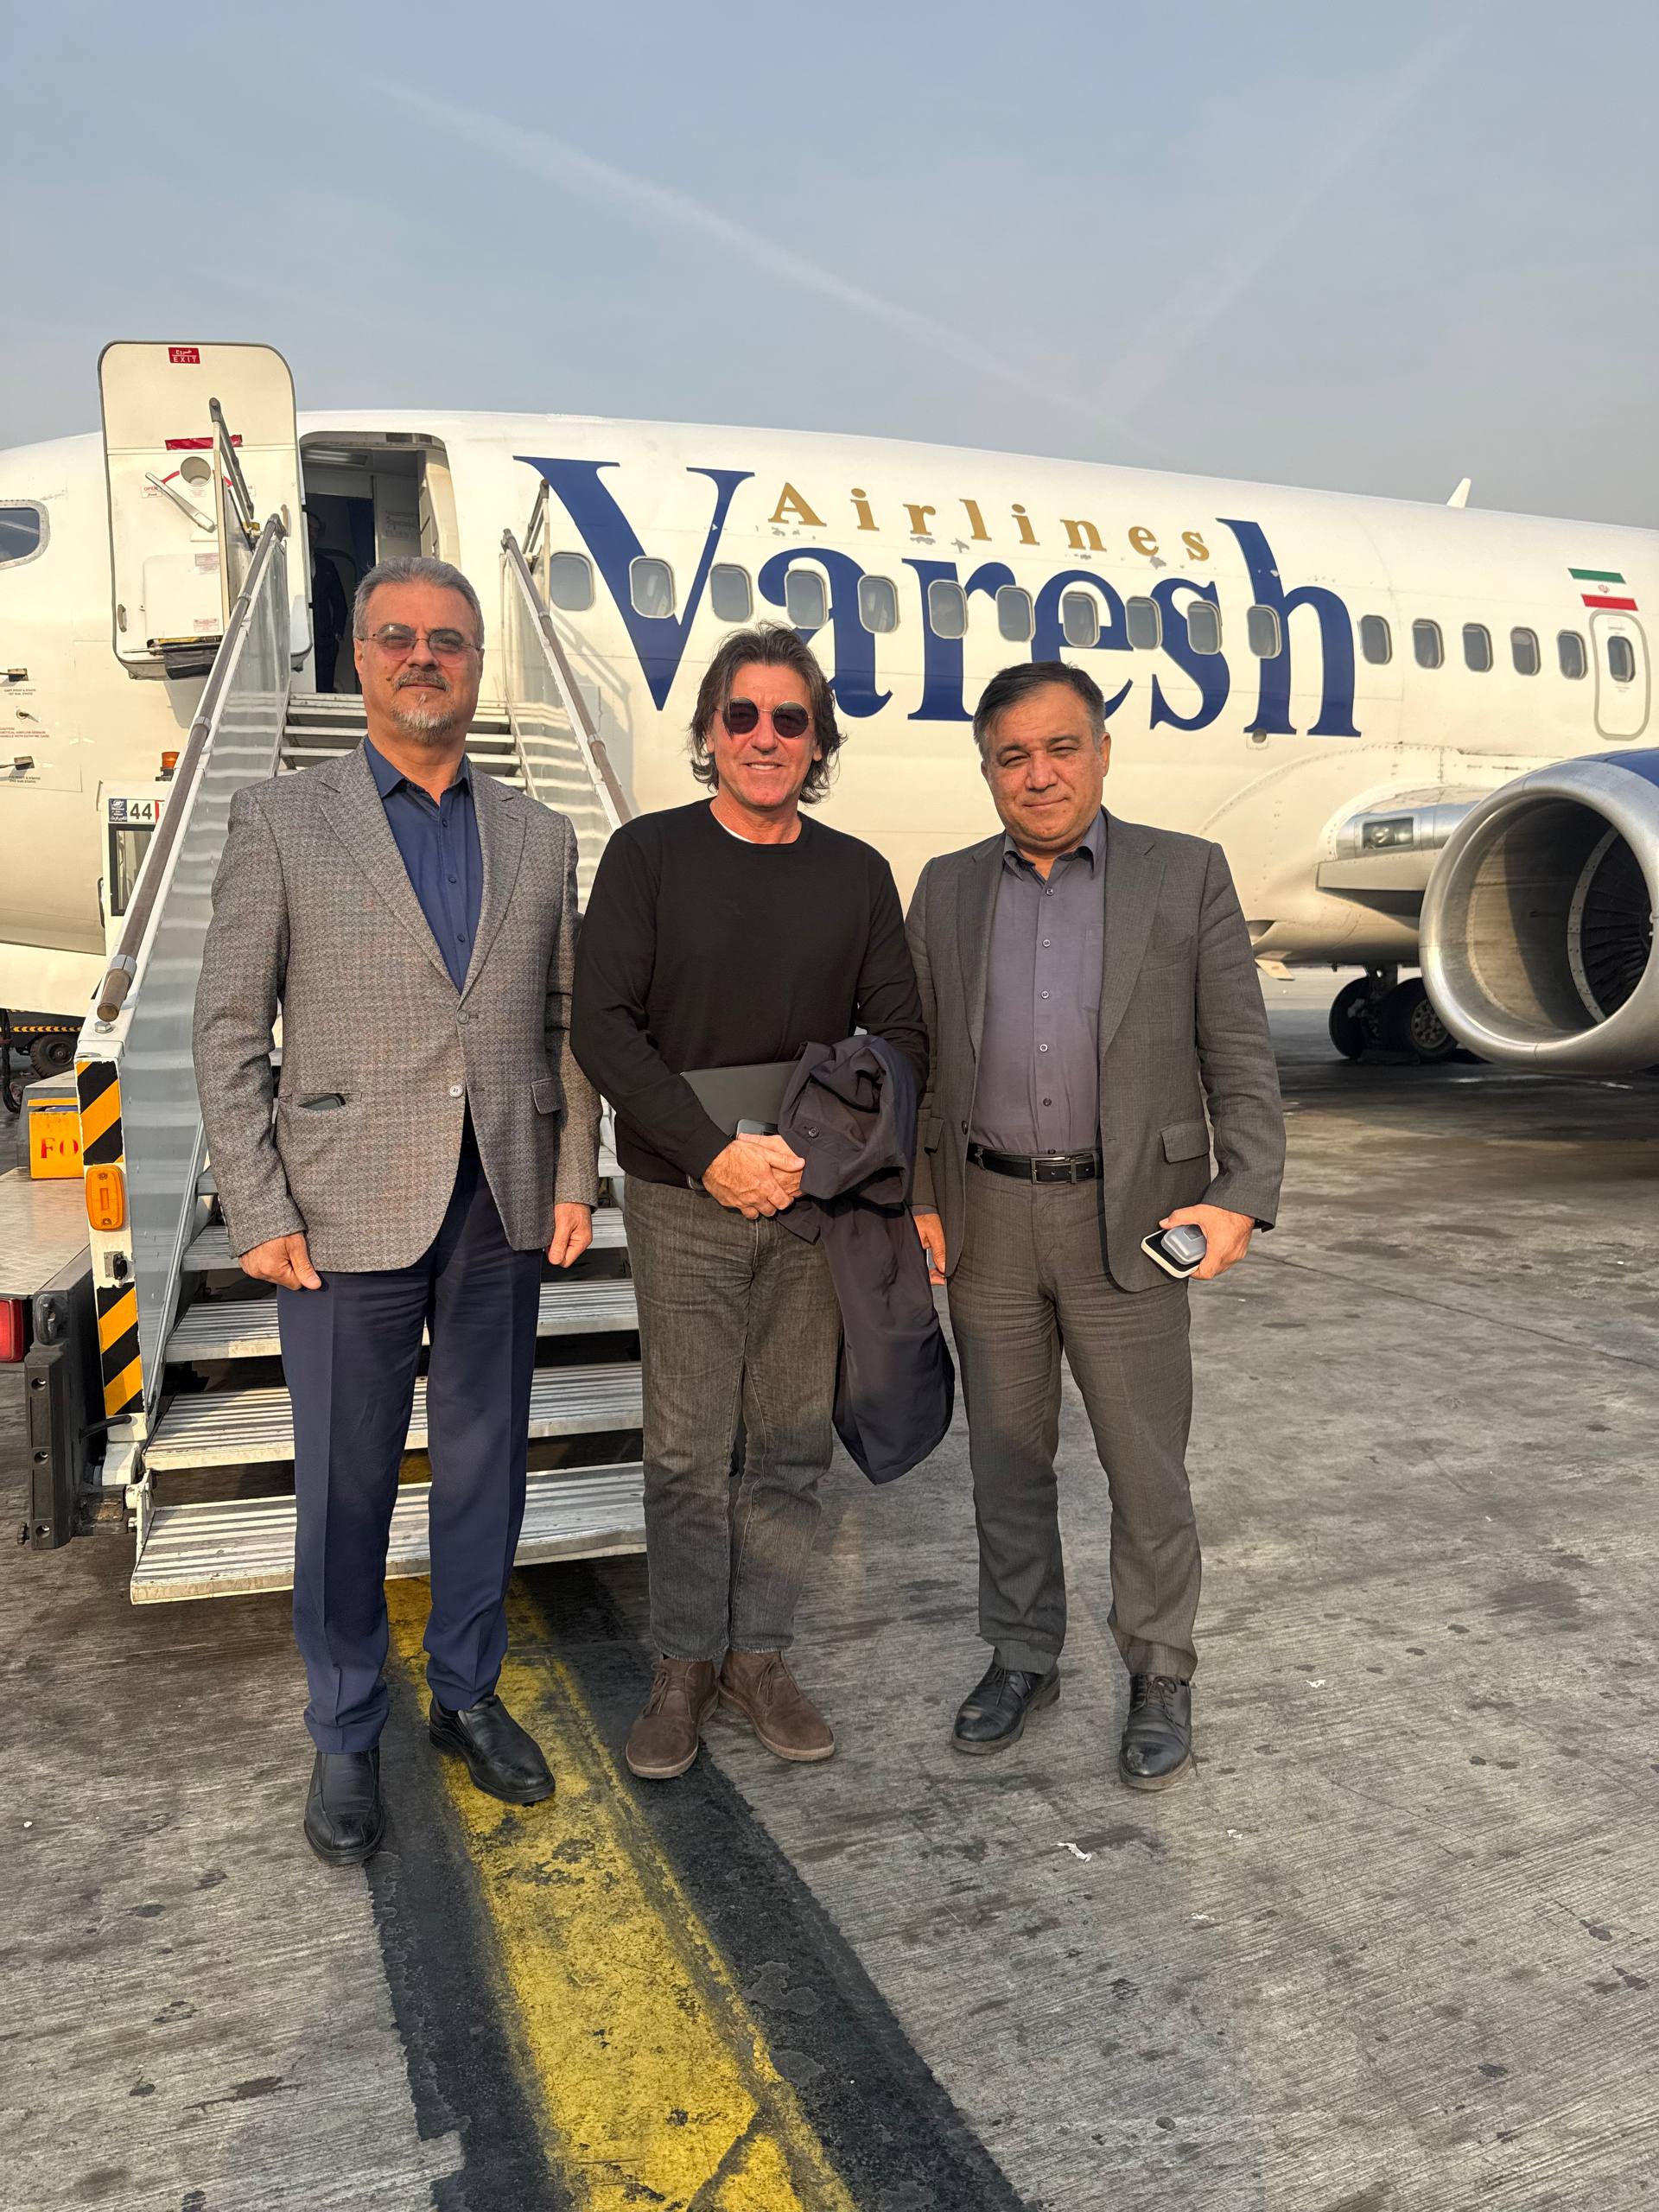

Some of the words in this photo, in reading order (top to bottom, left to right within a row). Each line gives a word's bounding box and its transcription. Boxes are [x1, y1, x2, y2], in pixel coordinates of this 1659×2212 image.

[768, 481, 1211, 562] Airlines
[513, 455, 1362, 737] Varesh
[130, 803, 152, 820] 44
